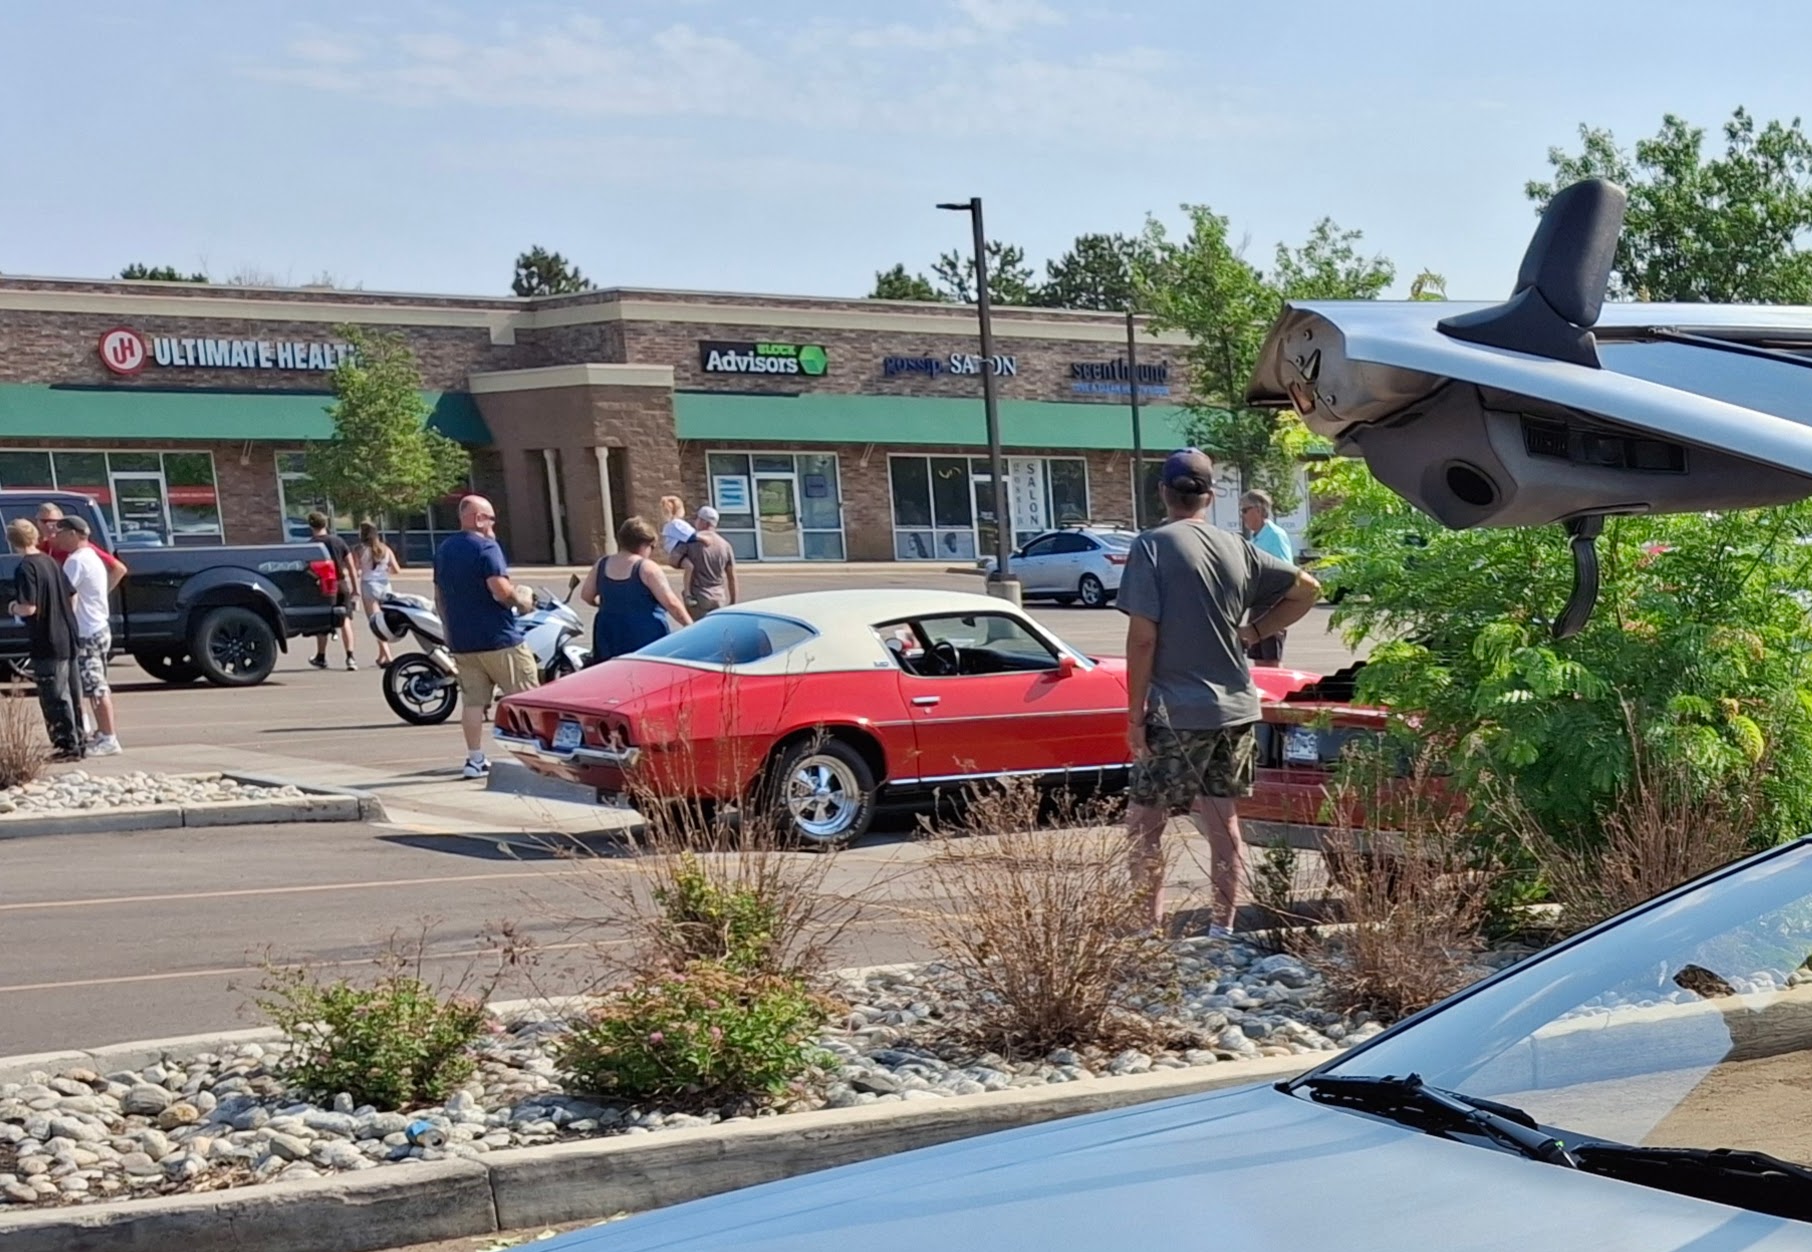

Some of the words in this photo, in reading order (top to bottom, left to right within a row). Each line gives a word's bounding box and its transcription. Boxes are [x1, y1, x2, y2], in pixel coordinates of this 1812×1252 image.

[153, 337, 273, 369] ULTIMATE
[706, 349, 799, 373] Advisors
[756, 343, 797, 355] BLOCK
[1072, 357, 1168, 383] scenthund
[1026, 463, 1039, 526] SALON
